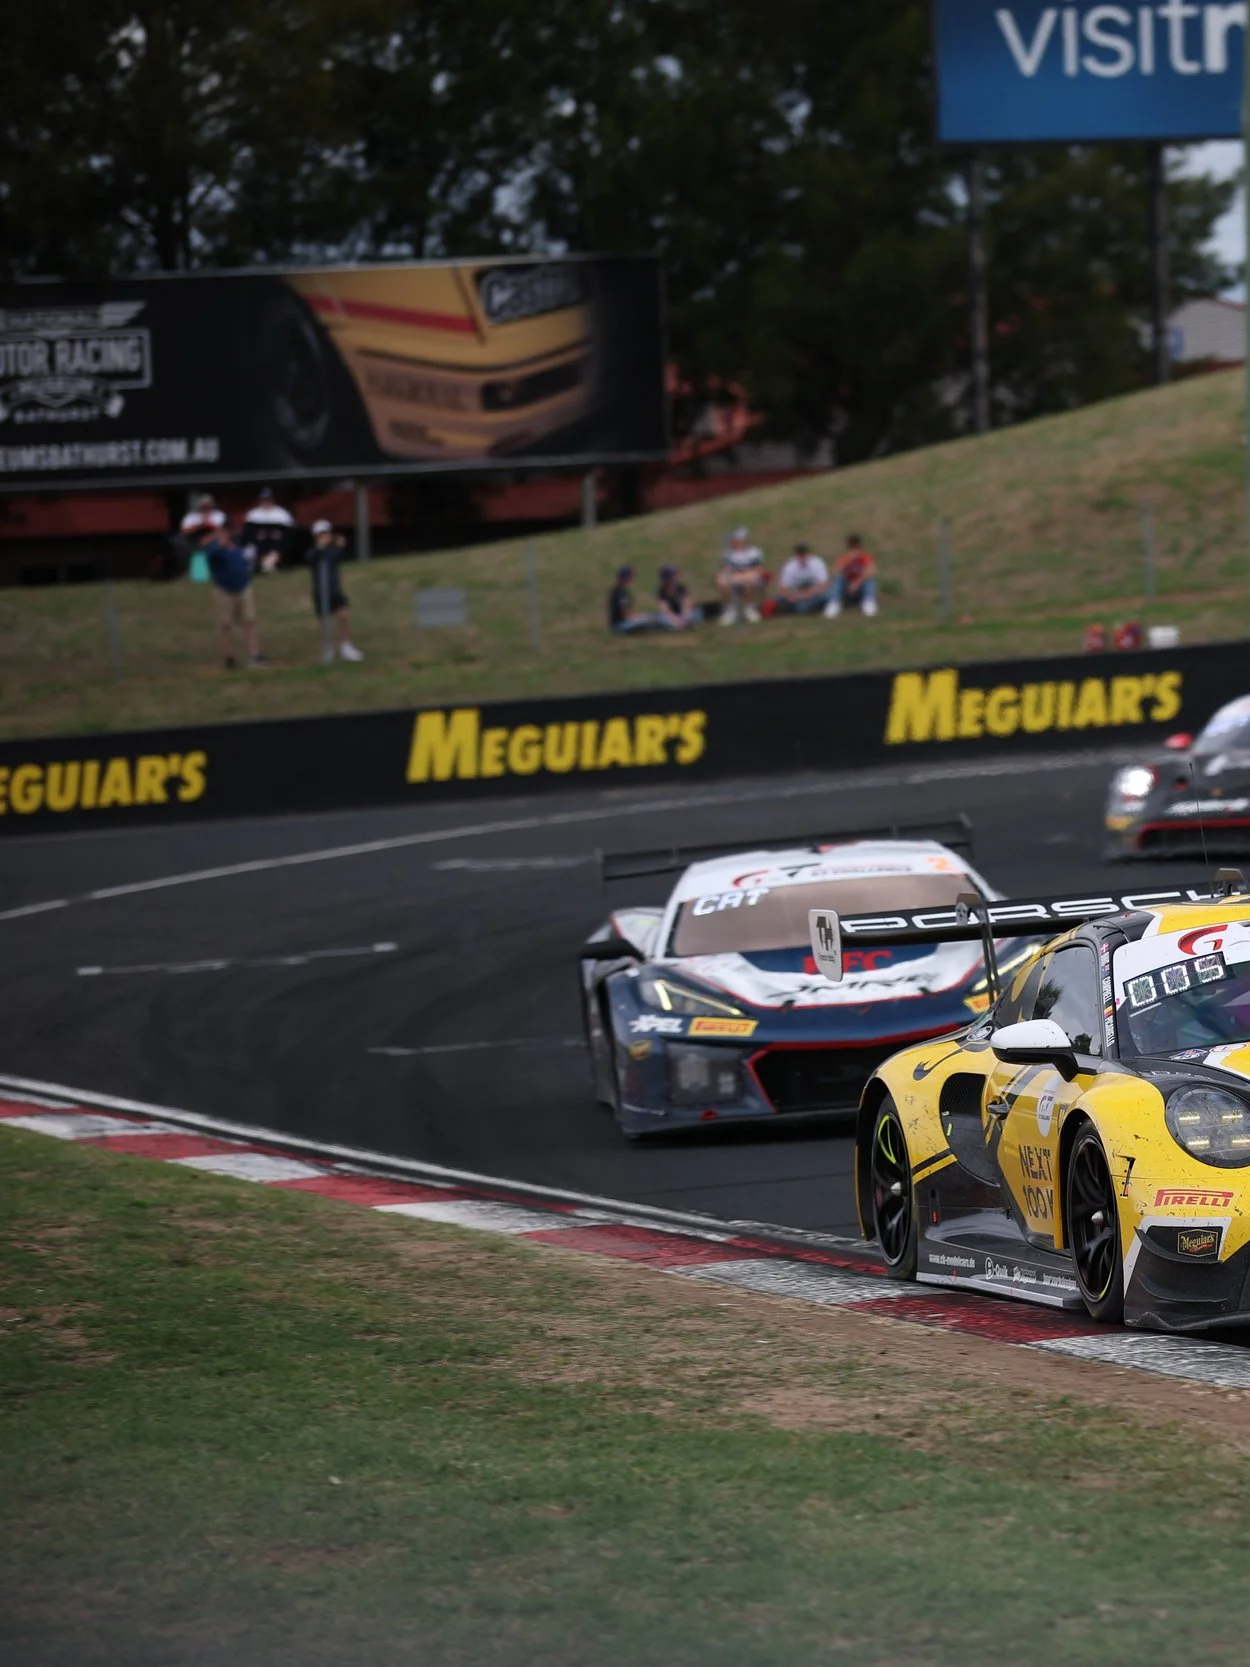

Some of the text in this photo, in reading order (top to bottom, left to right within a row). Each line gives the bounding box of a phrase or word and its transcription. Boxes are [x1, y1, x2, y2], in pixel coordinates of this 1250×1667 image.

[56, 337, 141, 373] RACING
[884, 668, 1183, 744] MEGUIAR'S
[407, 709, 707, 783] MEGUIAR'S
[692, 887, 770, 916] CAT
[1127, 954, 1224, 1007] 005
[1018, 1144, 1053, 1182] NEXT
[1154, 1189, 1234, 1207] PIRELLI
[1181, 1234, 1214, 1250] Meguiar's
